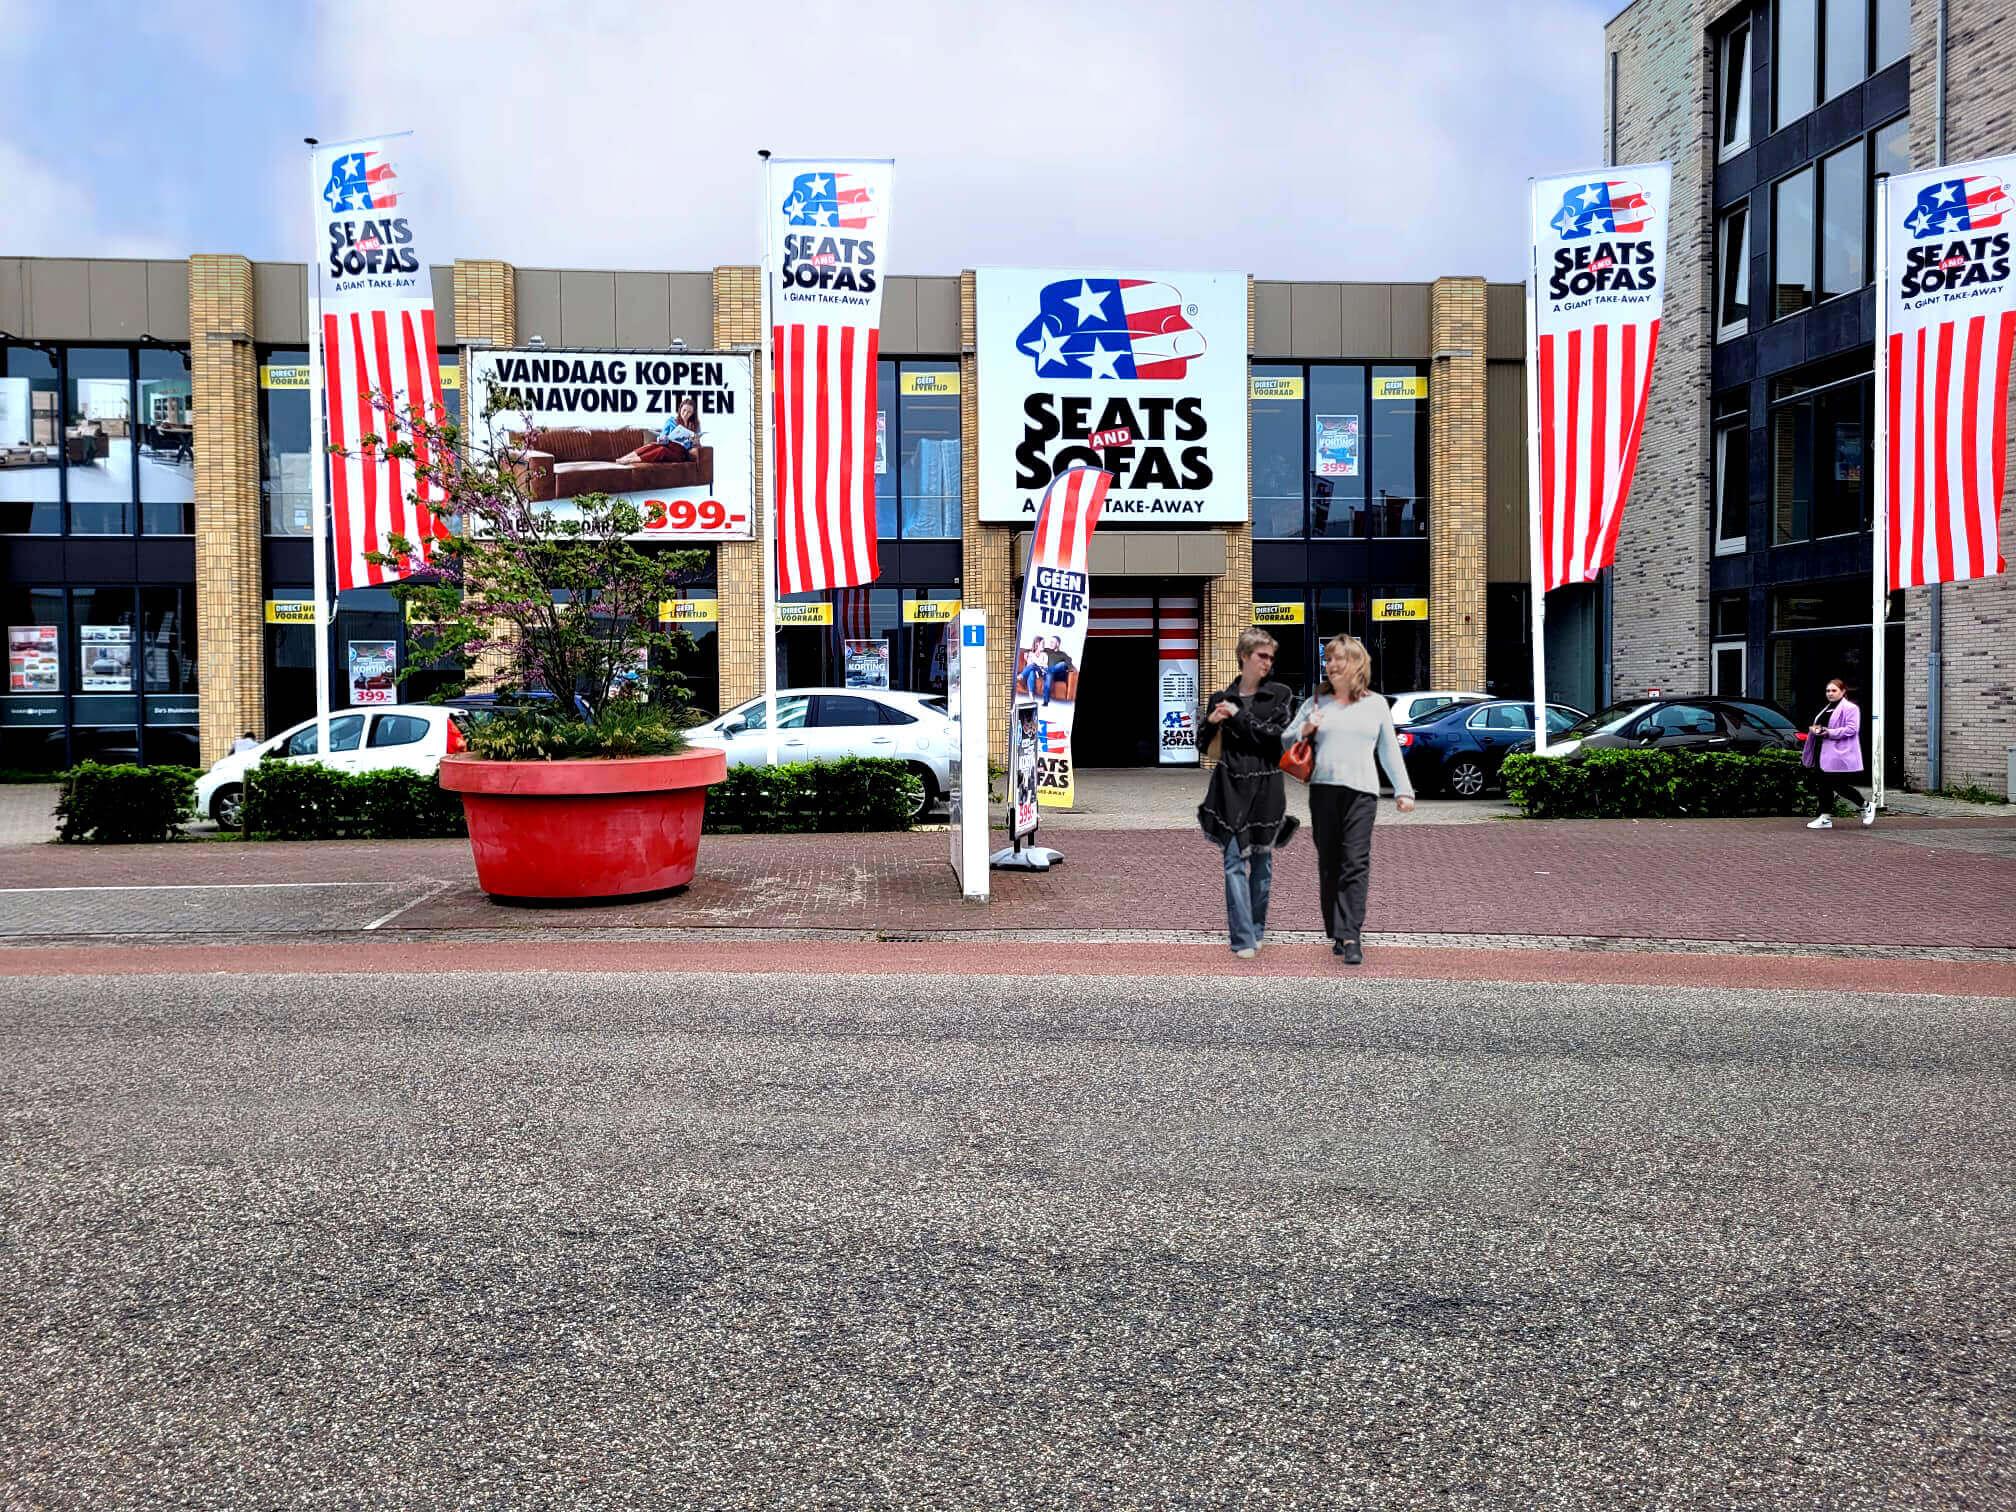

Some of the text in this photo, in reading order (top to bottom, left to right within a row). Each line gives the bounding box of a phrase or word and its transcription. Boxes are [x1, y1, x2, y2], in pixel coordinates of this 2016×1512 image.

[329, 218, 412, 249] SEATS
[784, 233, 875, 266] SEATS
[1554, 240, 1655, 273] SEATS
[1907, 232, 2011, 272] SEATS
[330, 247, 419, 278] SOFAS
[782, 263, 877, 293] SOFAS
[1550, 266, 1657, 300] SOFAS
[1901, 257, 2011, 300] SOFAS
[790, 292, 816, 303] GIANT
[818, 294, 871, 306] TAKE-AWAY
[1553, 295, 1651, 312] A GIANT TAKE-AWAY
[1904, 302, 1911, 311] A
[1943, 286, 2004, 302] TAKE-AWAY
[495, 358, 728, 389] VANDAAG KOPEN,
[1279, 381, 1291, 389] UIT
[645, 388, 735, 414] ZITTEN
[1023, 392, 1207, 442] SEATS
[1092, 429, 1130, 448] AND
[1022, 497, 1205, 514] A TAKE-AWAY
[1039, 570, 1082, 592] GEEN
[1031, 586, 1087, 612] LEVER-
[275, 612, 315, 620] VOORRAA
[781, 614, 823, 622] VOORRAAD
[782, 607, 806, 615] DIRECT
[1040, 605, 1076, 628] TIJD
[1255, 613, 1295, 621] VOORRAAD
[352, 665, 393, 674] KORTING
[848, 663, 886, 672] KORTING
[357, 690, 392, 702] 399.-
[1162, 738, 1195, 746] SOFAS
[1163, 729, 1194, 738] SEATS
[1037, 756, 1069, 774] ATS
[1037, 773, 1069, 789] FAS
